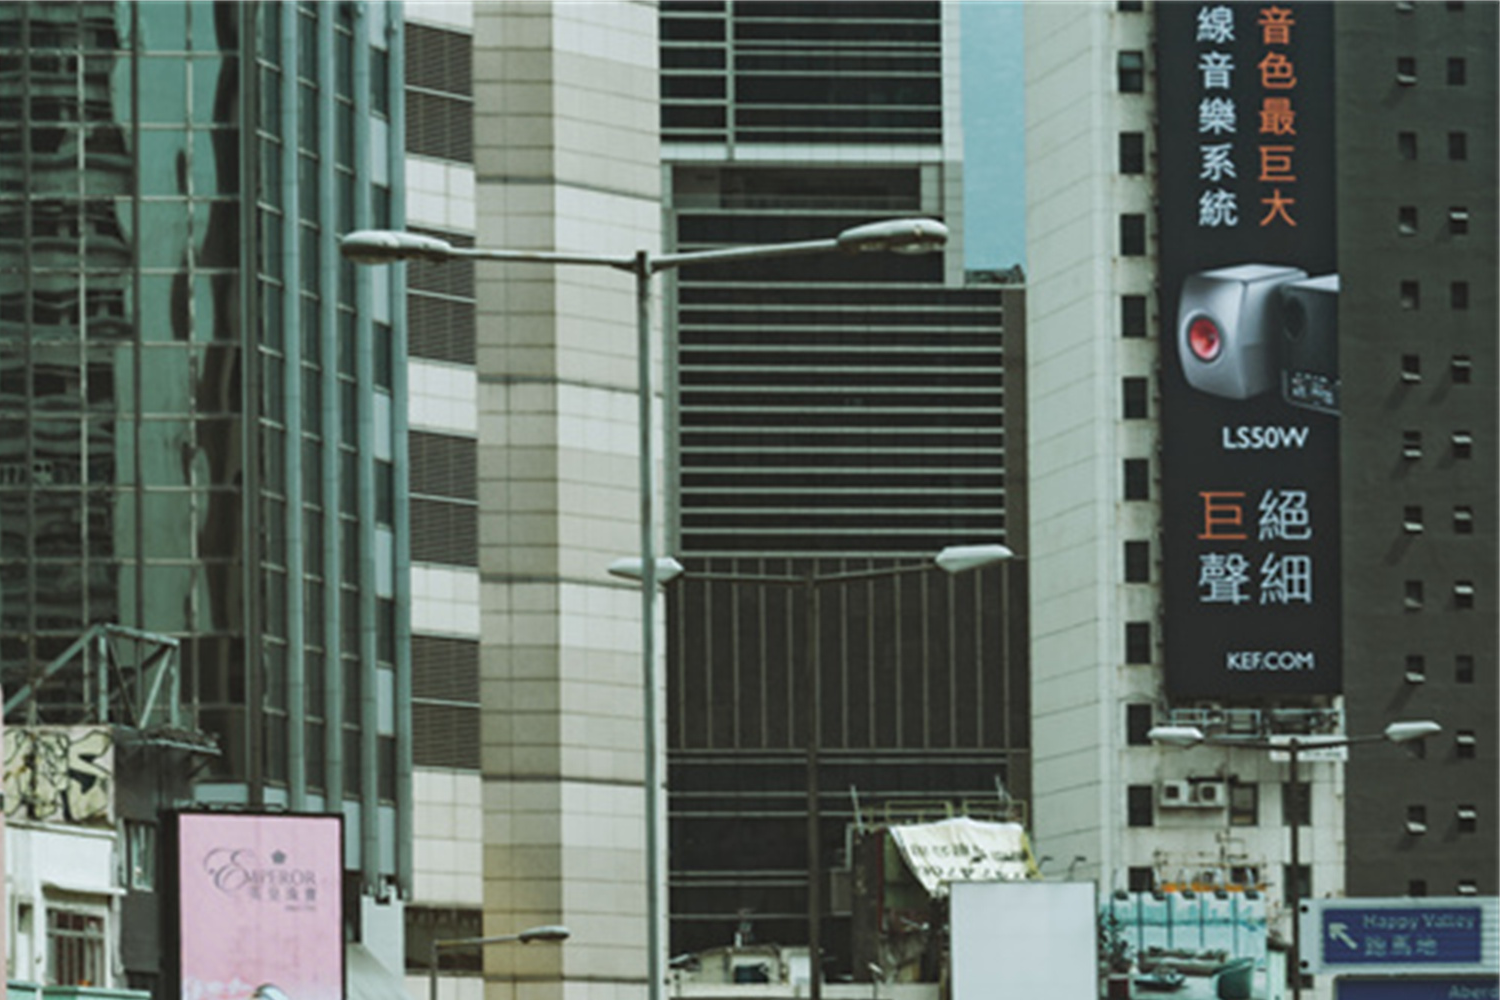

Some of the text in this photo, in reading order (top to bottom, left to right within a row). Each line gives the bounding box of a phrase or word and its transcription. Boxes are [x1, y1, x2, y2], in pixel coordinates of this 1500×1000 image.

[1196, 5, 1238, 226] 線音樂系統
[1257, 6, 1297, 226] 音色最巨大
[1222, 426, 1309, 448] LS50W
[1226, 652, 1314, 670] KEF.COM
[1363, 913, 1476, 930] Happy Valley
